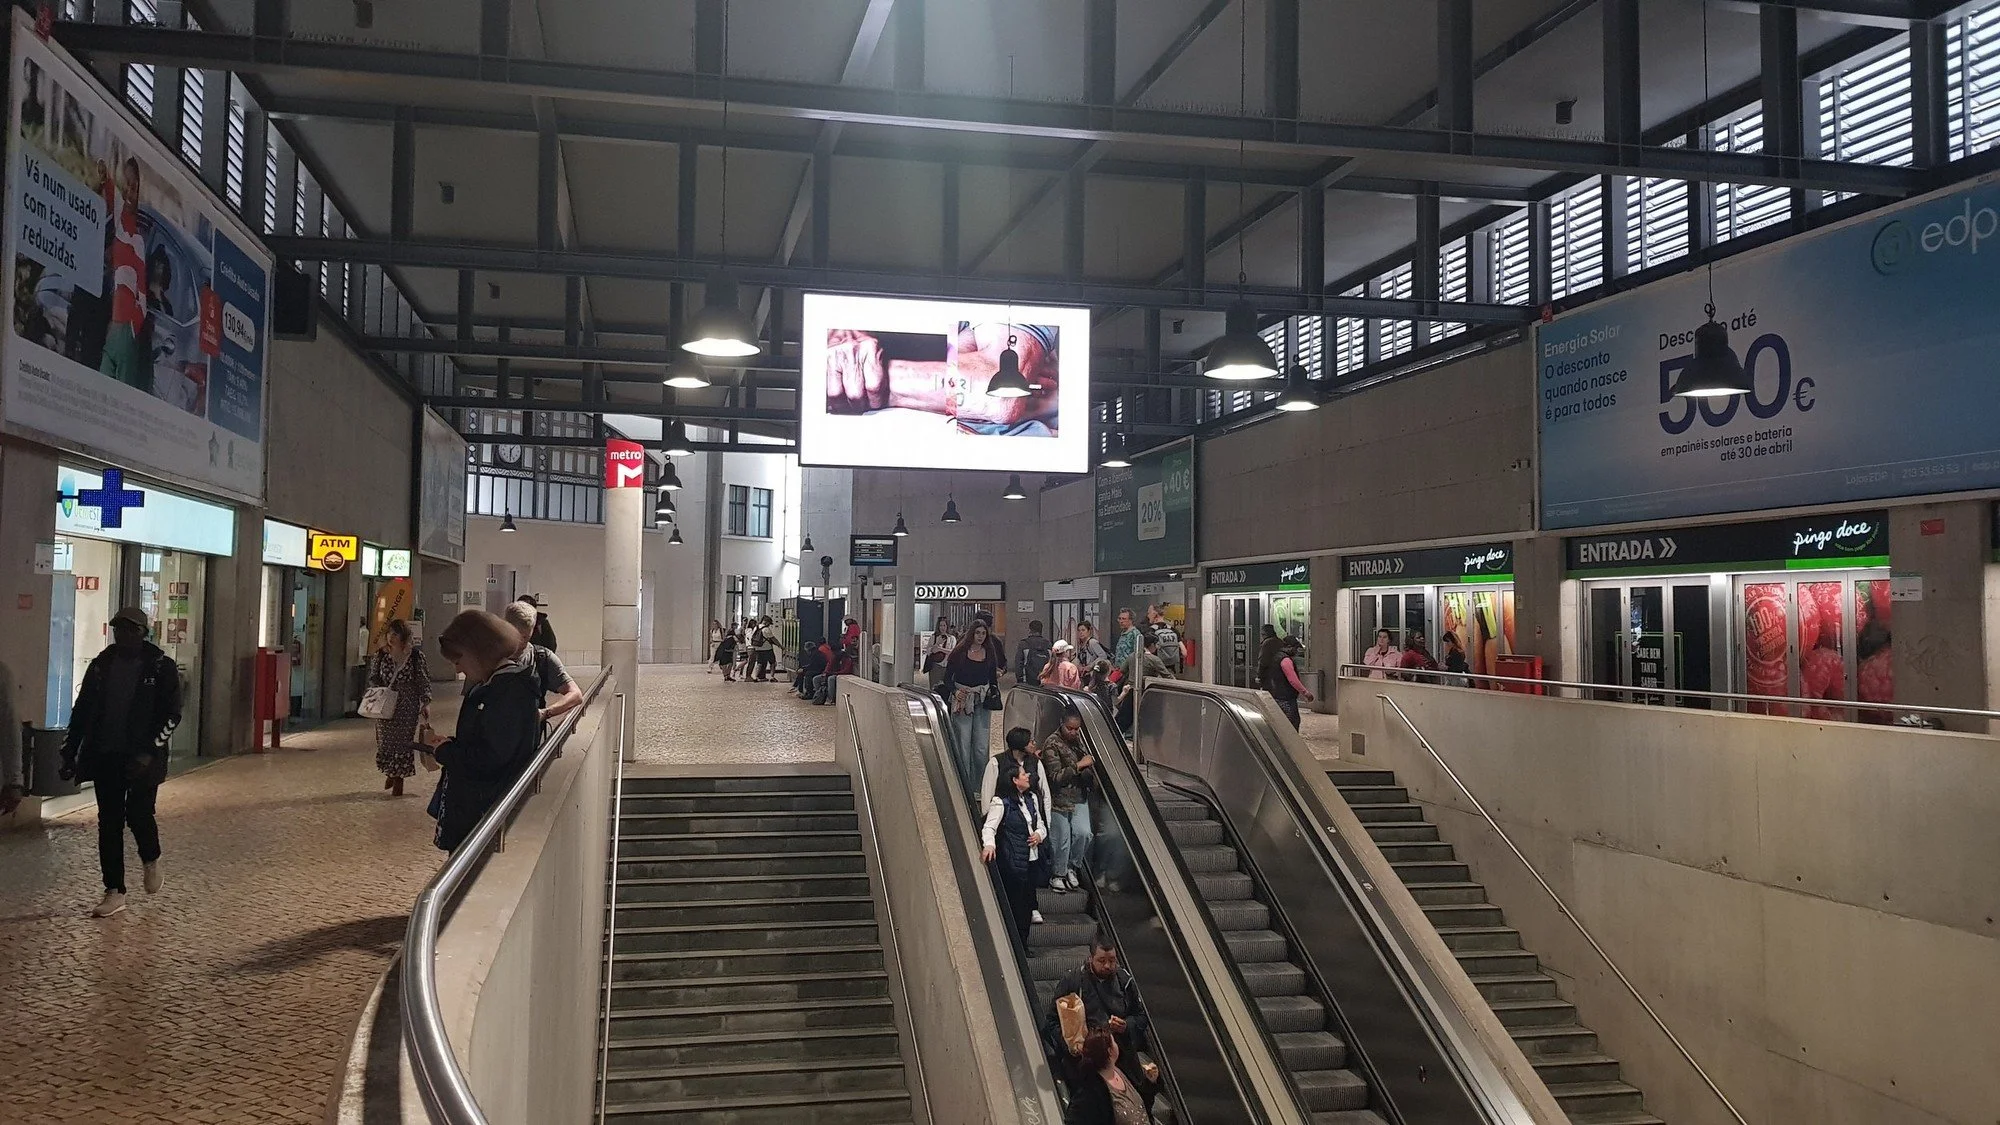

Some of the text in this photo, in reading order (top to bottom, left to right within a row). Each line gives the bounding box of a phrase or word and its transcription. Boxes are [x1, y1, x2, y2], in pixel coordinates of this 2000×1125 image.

[25, 153, 99, 229] Vá num usado,
[23, 192, 78, 241] com taxas
[1921, 197, 1999, 254] edp
[22, 224, 77, 271] reduzidas.
[1544, 324, 1621, 358] Energia Solar
[1659, 308, 1757, 350] Desco até
[1545, 351, 1610, 380] O desconto
[1545, 369, 1627, 401] quando nasce
[1545, 392, 1616, 423] é para todos
[1661, 425, 1792, 458] em painéis solares e bateria
[1720, 439, 1793, 462] até 30 de abril
[610, 450, 642, 460] metro
[1142, 500, 1162, 523] 20%
[320, 538, 350, 548] ATM
[1793, 519, 1871, 555] pingo doce
[1464, 548, 1505, 573] pingo doce
[1579, 538, 1655, 563] ENTRADA
[1211, 570, 1239, 585] ENTRADA
[1280, 563, 1306, 583] pingo doce
[1350, 559, 1391, 577] ENTRADA
[916, 586, 967, 598] ONYMO
[1636, 647, 1661, 659] SABE BEM
[1640, 662, 1657, 674] TANTO
[1640, 676, 1658, 688] SABOR
